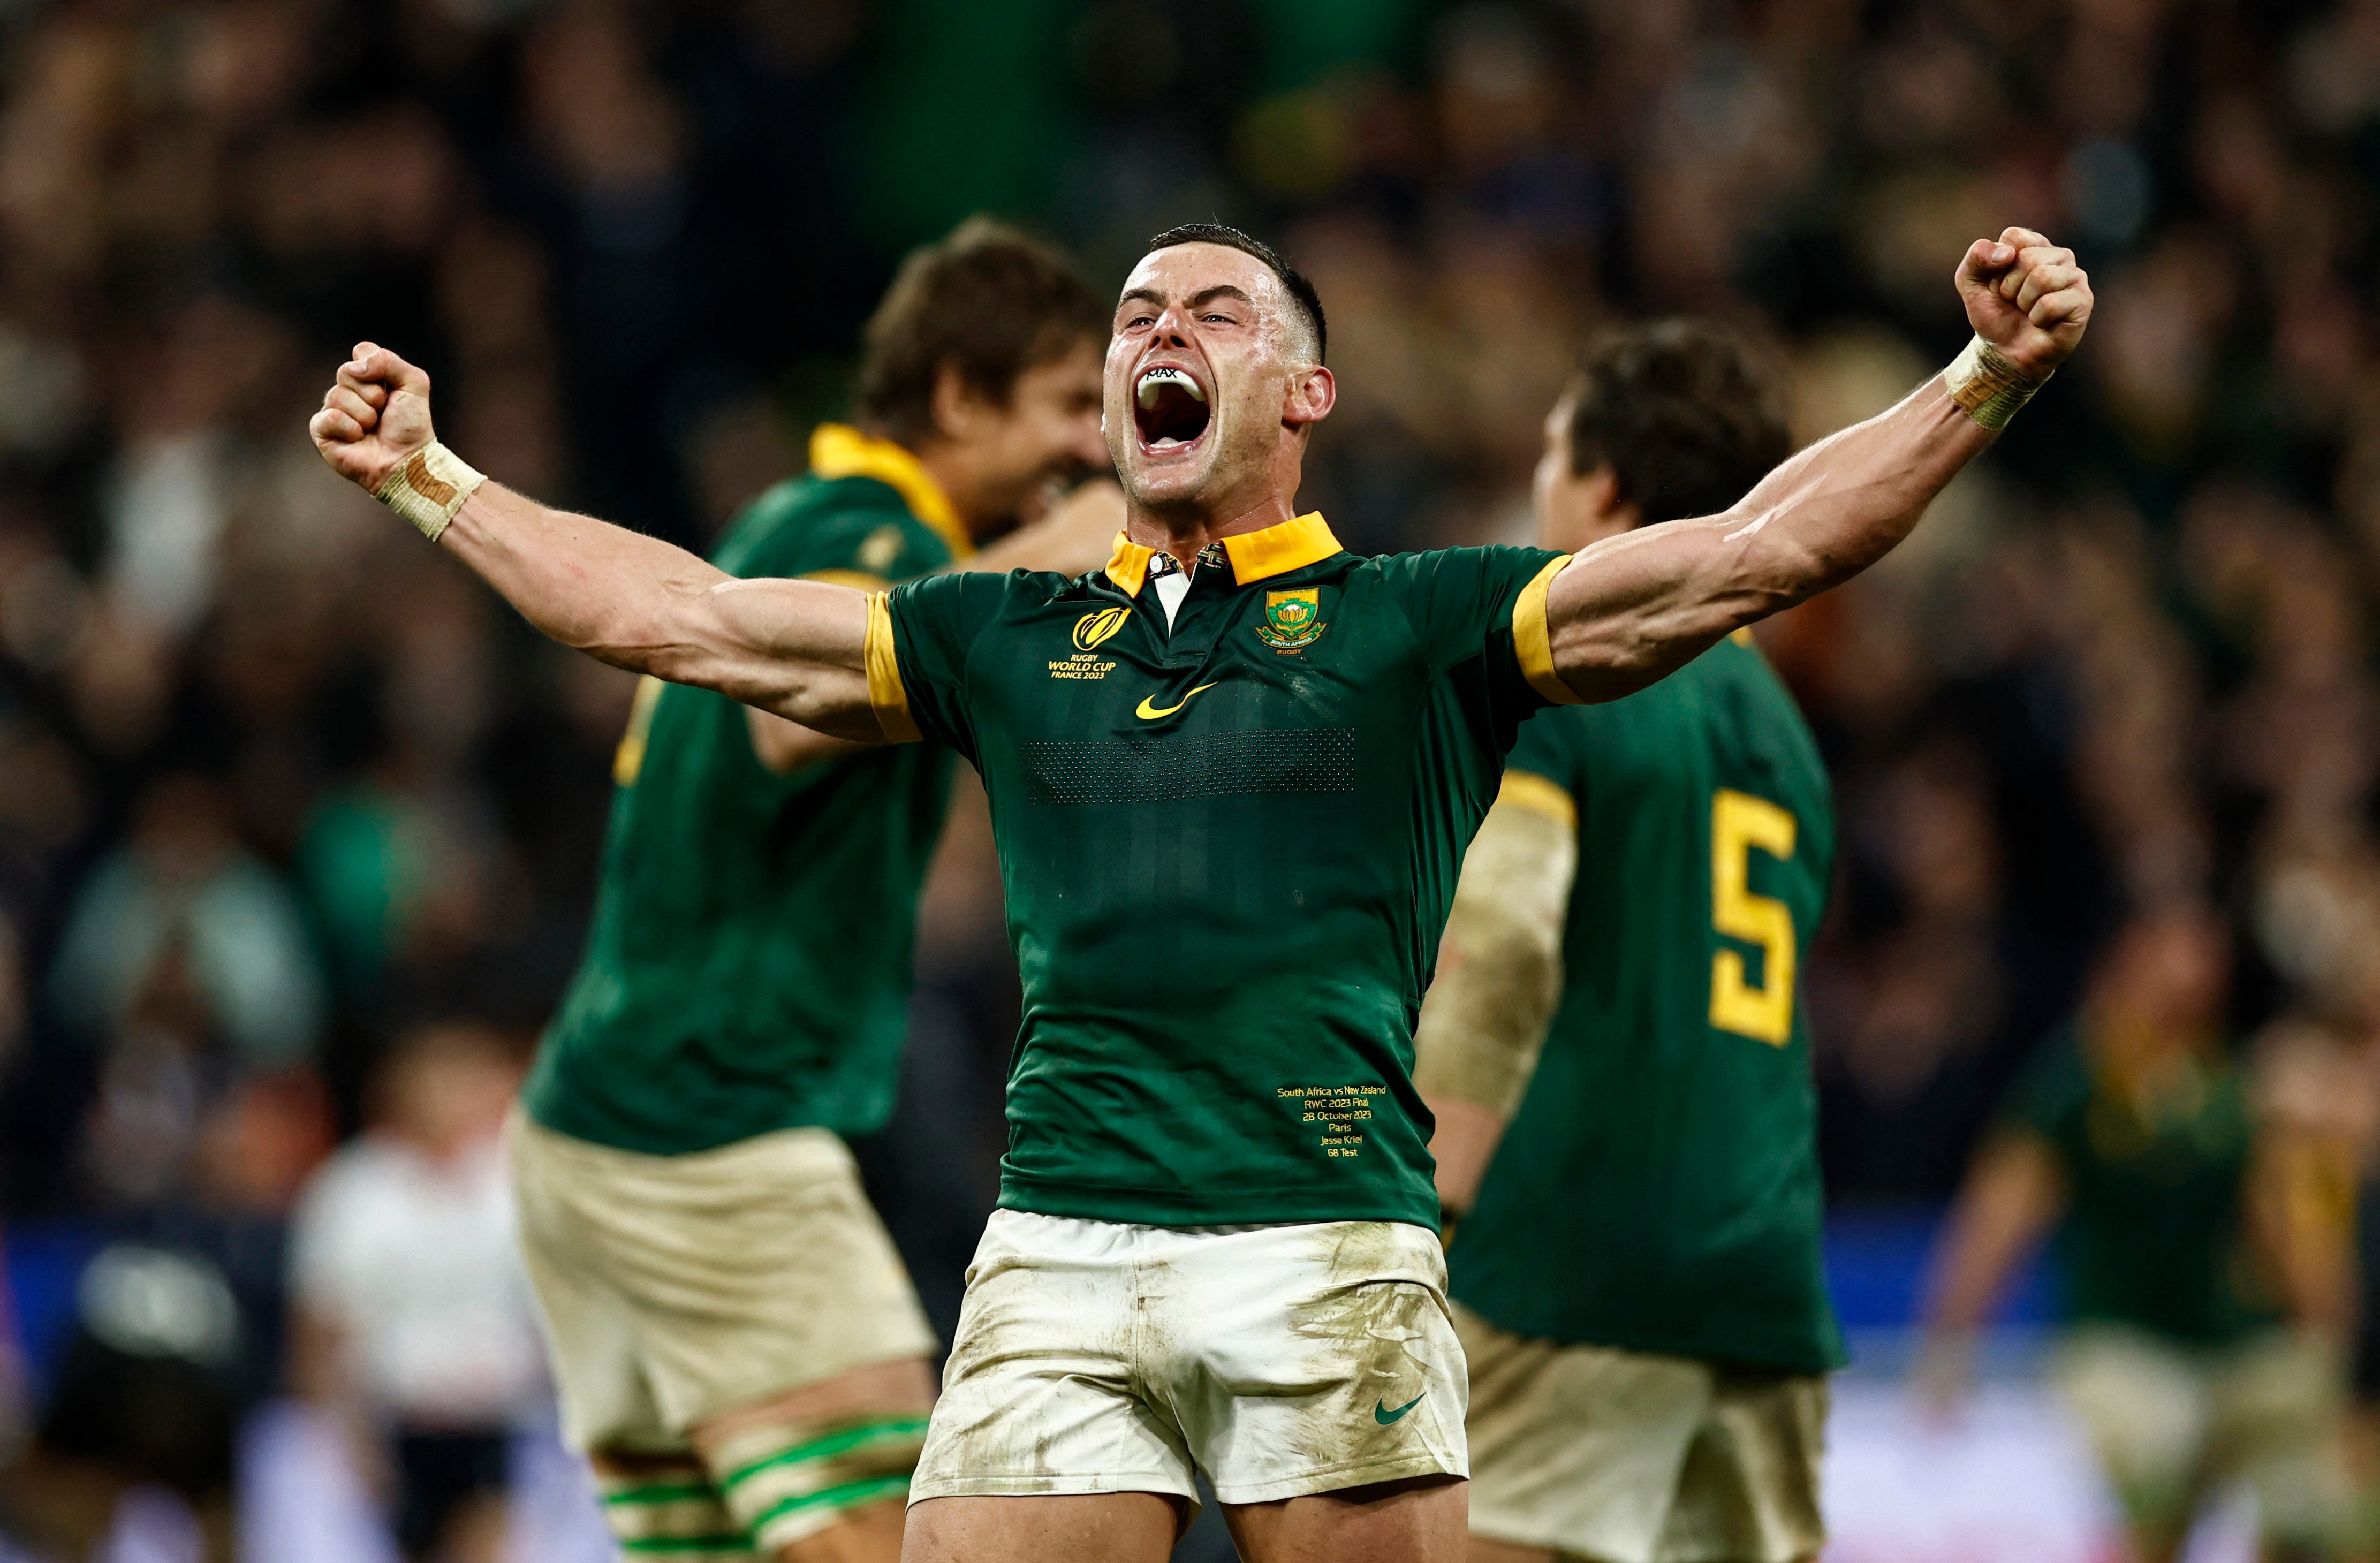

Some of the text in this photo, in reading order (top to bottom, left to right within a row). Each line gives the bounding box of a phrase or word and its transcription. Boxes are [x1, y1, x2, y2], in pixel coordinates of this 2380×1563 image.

[1147, 368, 1177, 380] MAX
[1291, 637, 1313, 646] AFRICA
[1048, 661, 1117, 671] WORLD CUP
[1710, 787, 1797, 1049] 5
[1277, 1086, 1386, 1097] South Africa vs New Zealand
[1304, 1098, 1369, 1109] RWC 2023 Final
[1302, 1110, 1371, 1121] 28 October 2023
[1329, 1123, 1352, 1132] Paris
[1320, 1135, 1363, 1146] Jesse Kriel
[1328, 1148, 1358, 1157] 68 Test
